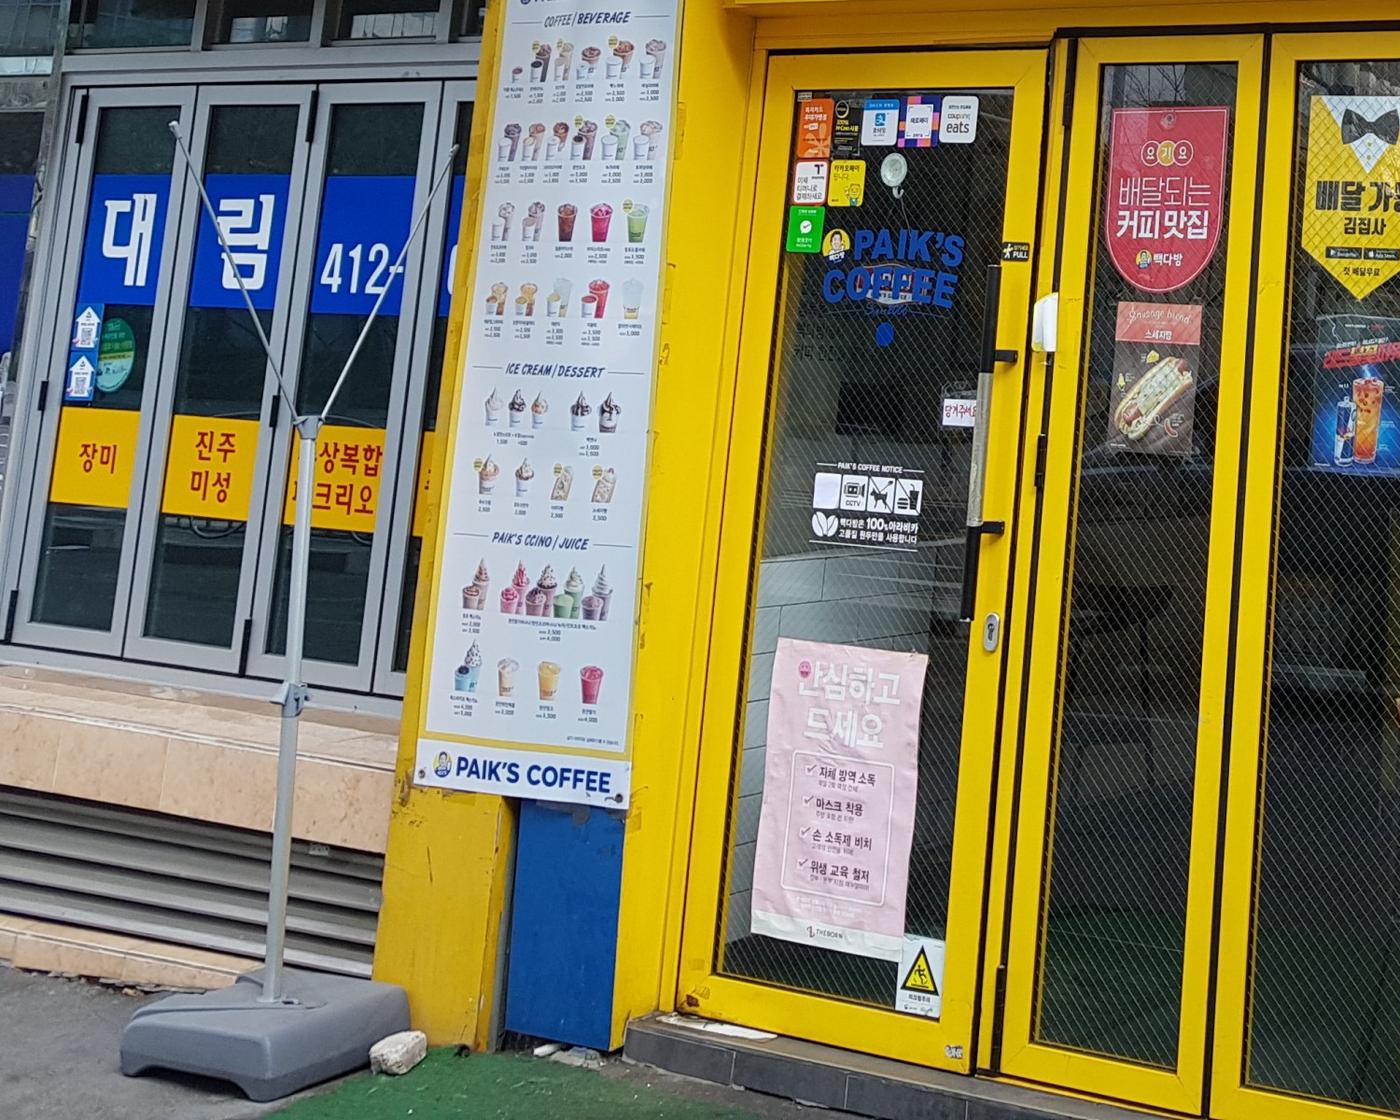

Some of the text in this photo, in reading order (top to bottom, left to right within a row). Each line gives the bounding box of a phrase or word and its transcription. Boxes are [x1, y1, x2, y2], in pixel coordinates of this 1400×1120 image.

[946, 121, 970, 134] eats
[1119, 176, 1211, 207] 배달되는
[1315, 181, 1366, 212] 배달
[1116, 210, 1209, 240] 커피 맛집
[1343, 216, 1387, 236] 김집사
[854, 228, 965, 268] PAIK'S
[1013, 251, 1029, 259] PULL
[823, 265, 959, 310] COFFEE
[505, 363, 520, 375] ICE
[79, 442, 117, 475] 장미
[195, 430, 236, 463] 진주
[300, 442, 384, 478] 상복합
[857, 463, 881, 472] COFFEE
[881, 465, 904, 474] NOTICE
[189, 469, 232, 504] 미성
[293, 482, 375, 516] 크리오
[491, 531, 522, 546] PAIK'S
[798, 658, 901, 706] 안심하고
[804, 708, 884, 750] 드세요
[456, 756, 612, 794] PAIK'S COFFEE
[819, 766, 836, 780] 자체
[838, 769, 857, 783] 방역
[858, 772, 877, 787] 소독
[816, 798, 843, 813] 마스크
[845, 801, 863, 817] 착용
[812, 829, 822, 842] 손
[825, 832, 852, 848] 소독제
[854, 836, 873, 851] 비치
[810, 860, 827, 876] 위생
[830, 864, 849, 879] 교육
[852, 867, 870, 883] 철저
